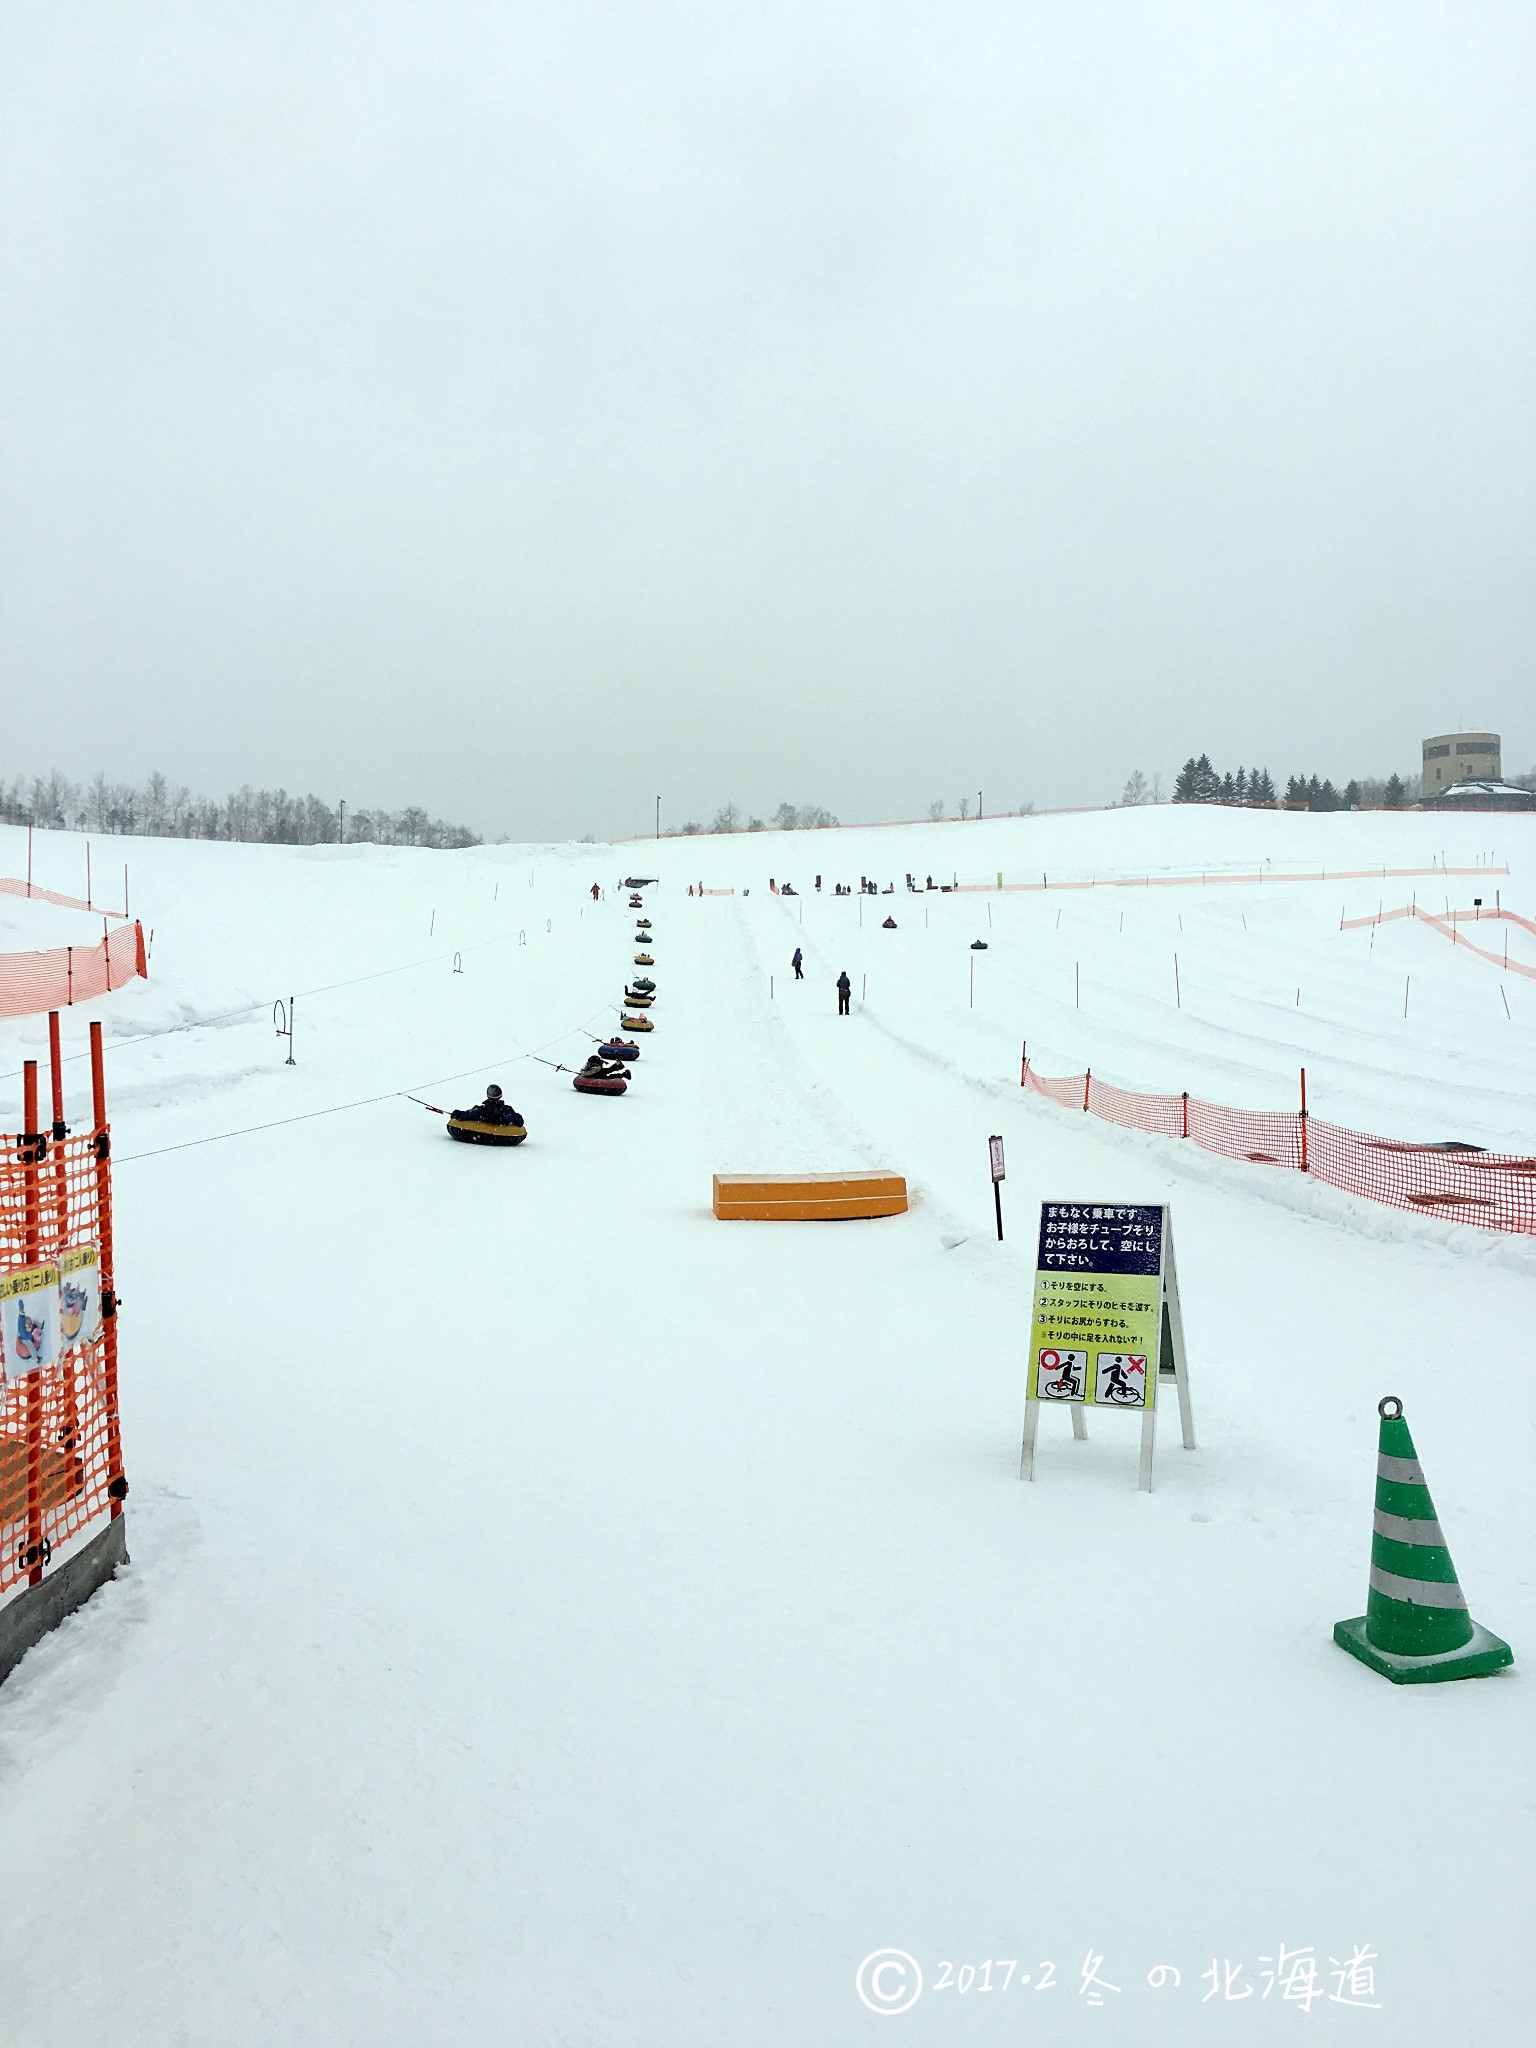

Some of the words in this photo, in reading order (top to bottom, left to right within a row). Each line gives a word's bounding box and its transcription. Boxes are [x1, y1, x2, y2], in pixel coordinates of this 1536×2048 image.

[1048, 1207, 1142, 1221] まもなく乗車です。
[1046, 1222, 1154, 1237] お子様をチューブそり
[1045, 1238, 1155, 1252] からおろして、空にし
[1044, 1253, 1093, 1267] て下さい。
